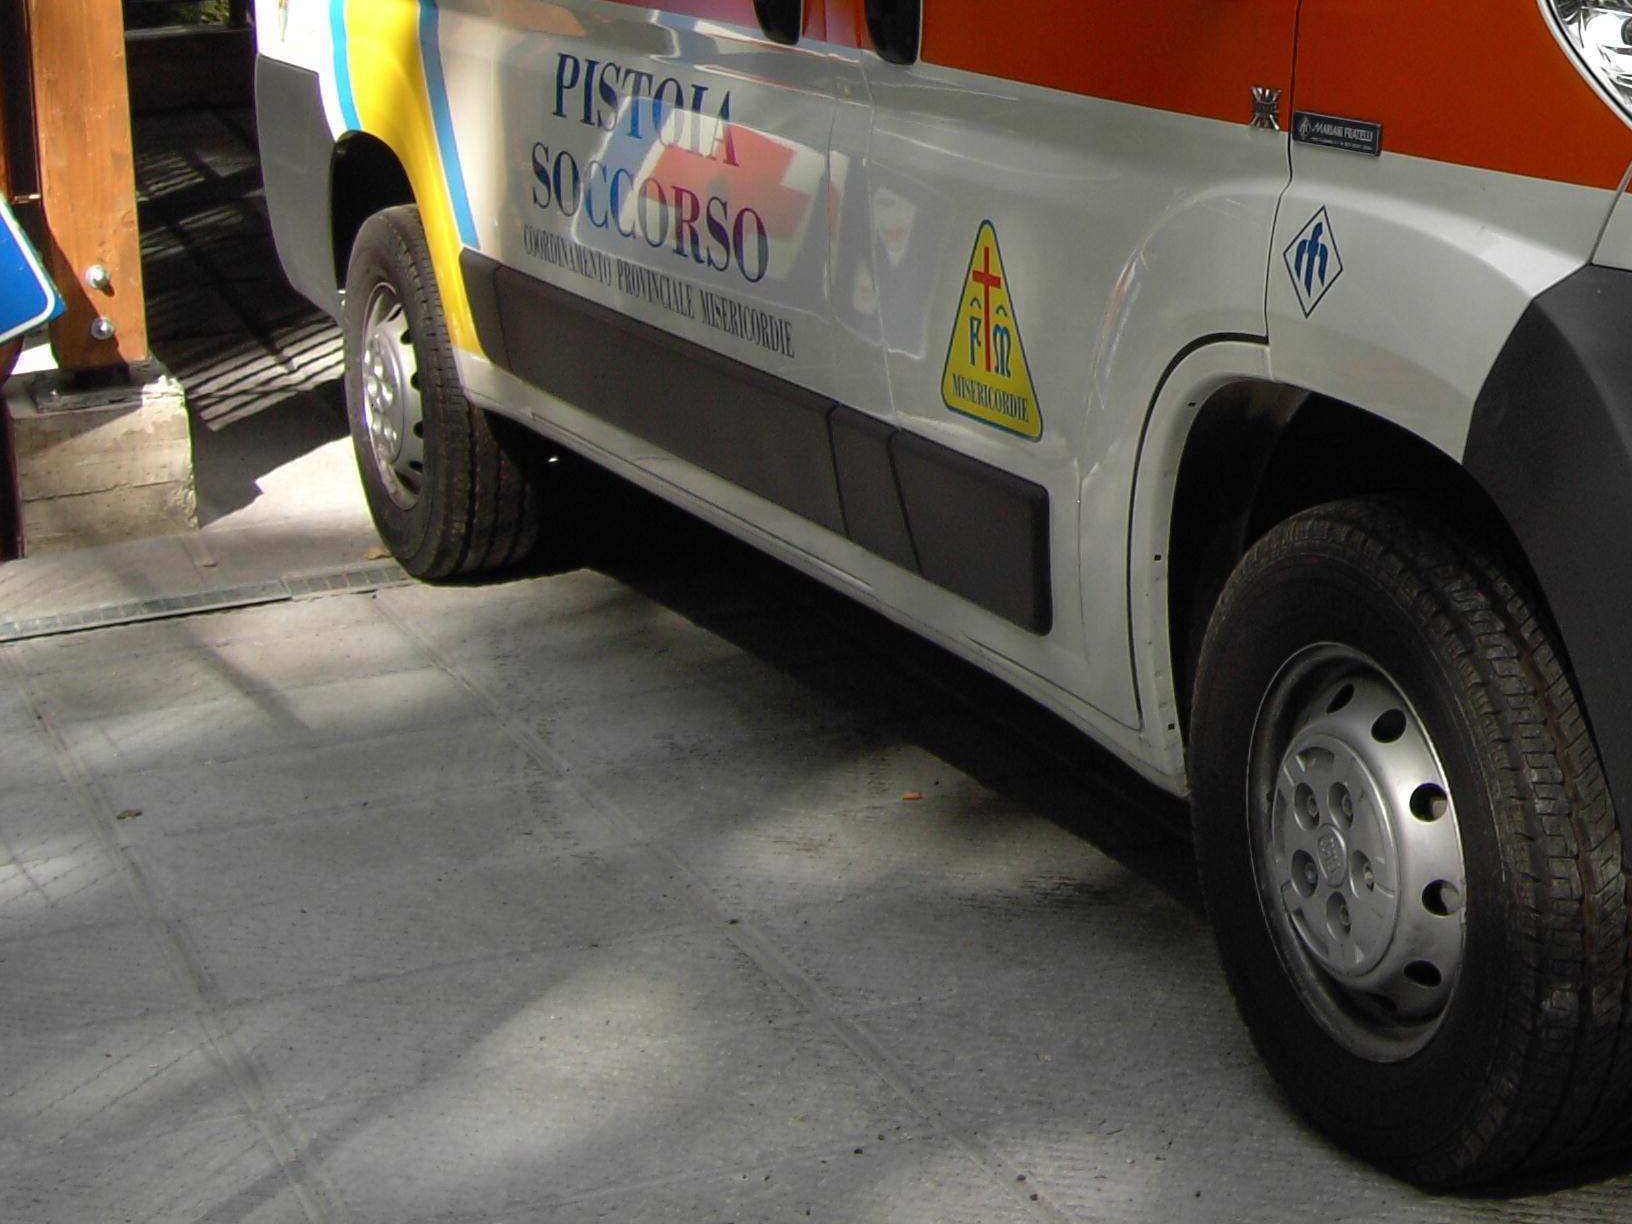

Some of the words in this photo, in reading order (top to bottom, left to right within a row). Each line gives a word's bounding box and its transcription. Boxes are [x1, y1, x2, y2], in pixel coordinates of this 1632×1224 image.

[551, 52, 740, 168] PISTOIA
[531, 141, 770, 284] SOCCORSO
[523, 225, 613, 288] COORDINAMENTO
[616, 258, 696, 320] PROVINCIALE
[699, 289, 795, 359] MISERICORDIE
[952, 373, 1030, 424] MISERICORDIE
